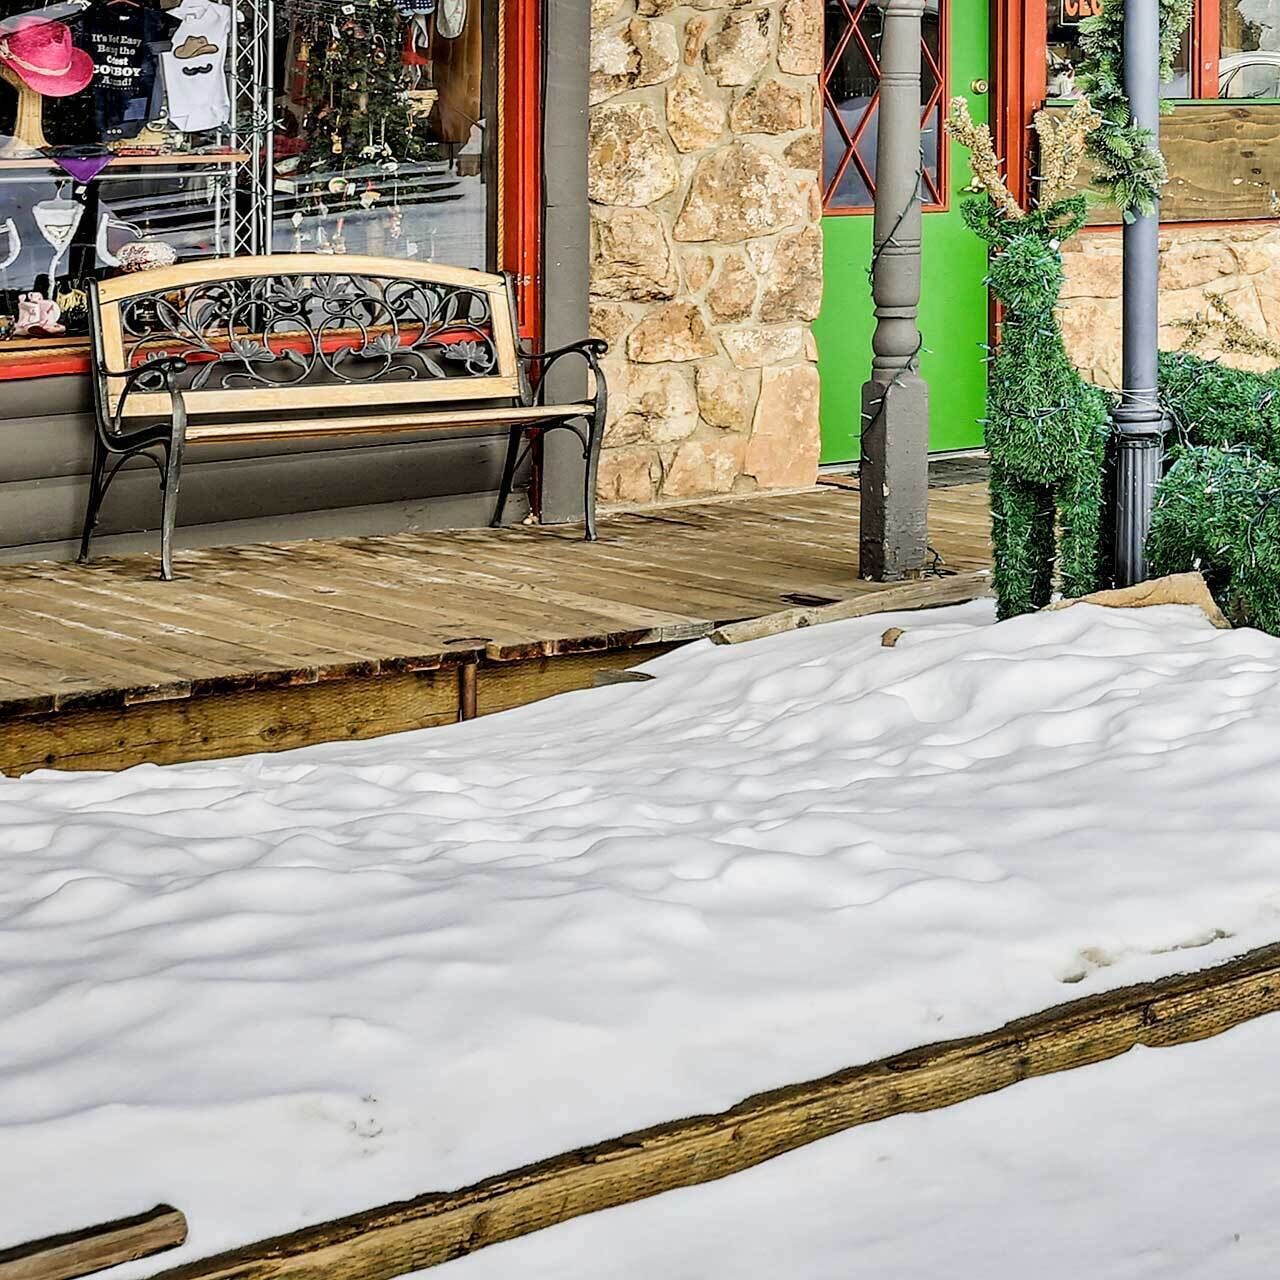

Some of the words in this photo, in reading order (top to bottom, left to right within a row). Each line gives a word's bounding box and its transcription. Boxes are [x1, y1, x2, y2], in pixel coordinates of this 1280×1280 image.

[91, 33, 108, 43] It's
[120, 35, 142, 48] Easy
[120, 46, 136, 55] the
